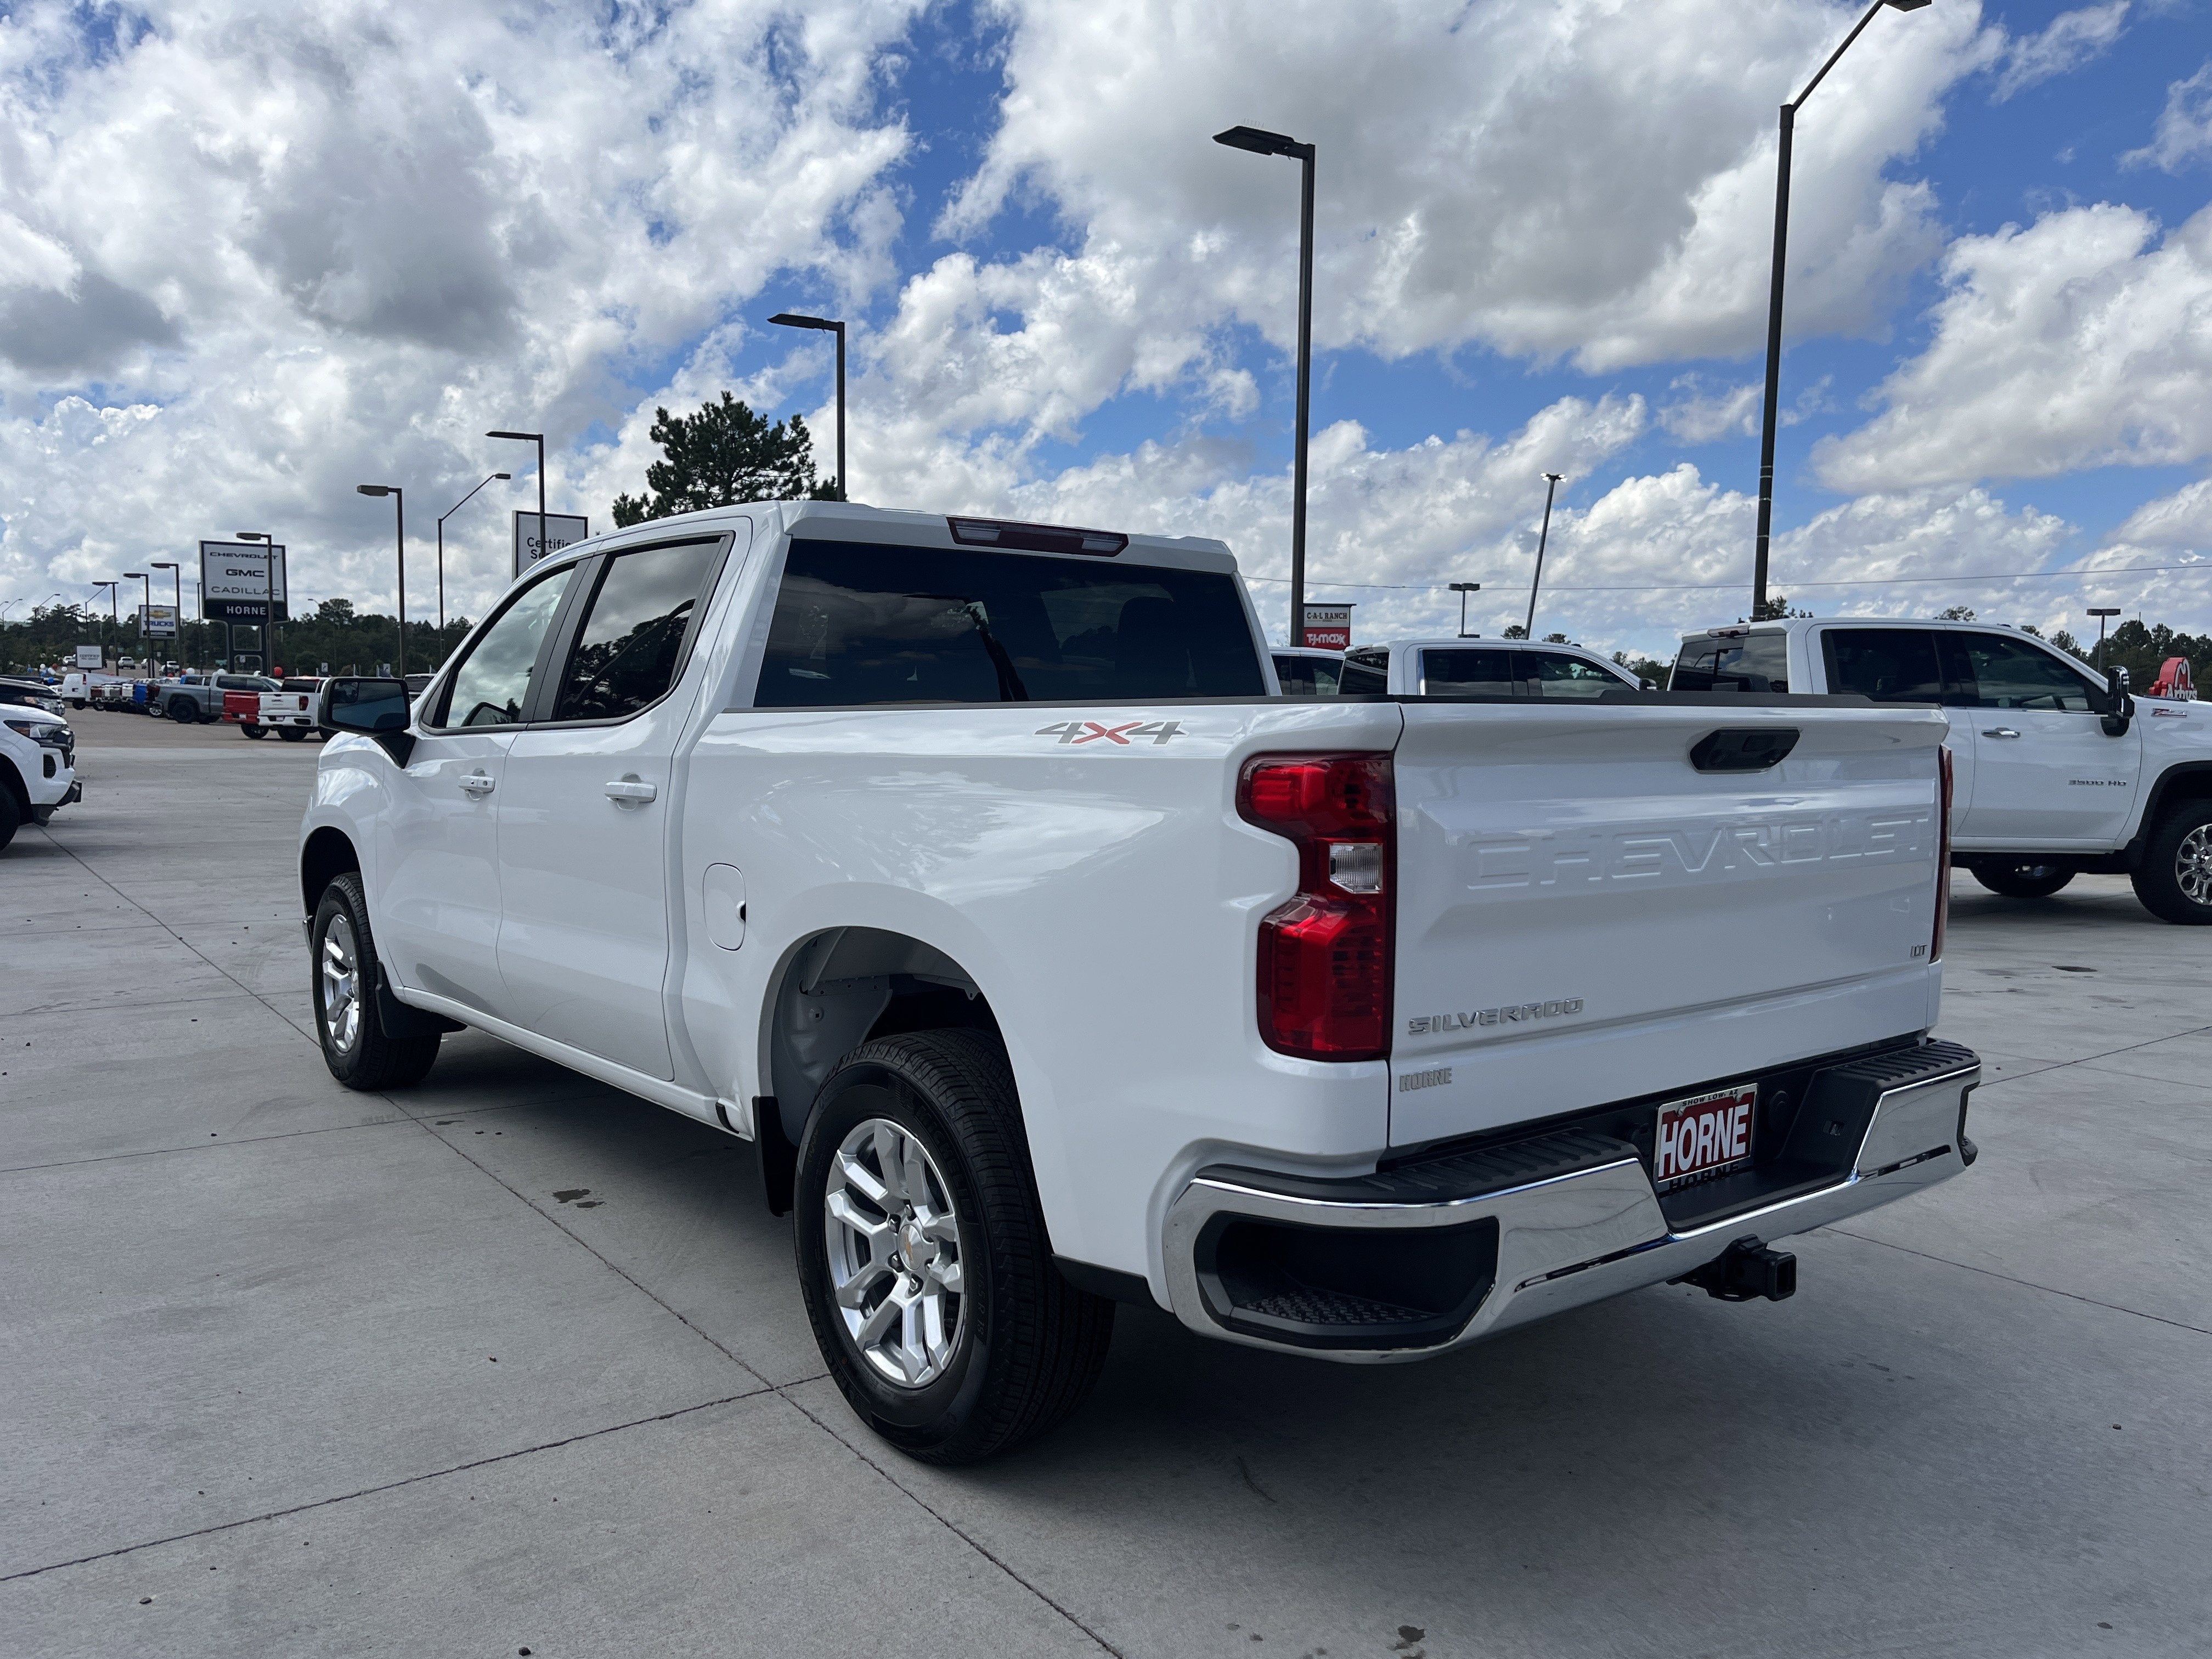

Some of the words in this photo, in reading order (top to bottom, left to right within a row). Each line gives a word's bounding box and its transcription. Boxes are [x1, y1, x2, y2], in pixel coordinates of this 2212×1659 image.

[527, 537, 571, 549] Cetifi
[225, 569, 264, 577] GMC
[211, 586, 280, 595] CADILLAC
[227, 606, 267, 615] HORNE
[1465, 814, 1931, 890] CHEVROLET
[1408, 996, 1584, 1035] SILVERADO
[1399, 1067, 1453, 1092] HORNE
[1682, 1097, 1705, 1107] SHOW
[1658, 1104, 1750, 1177] HORNE
